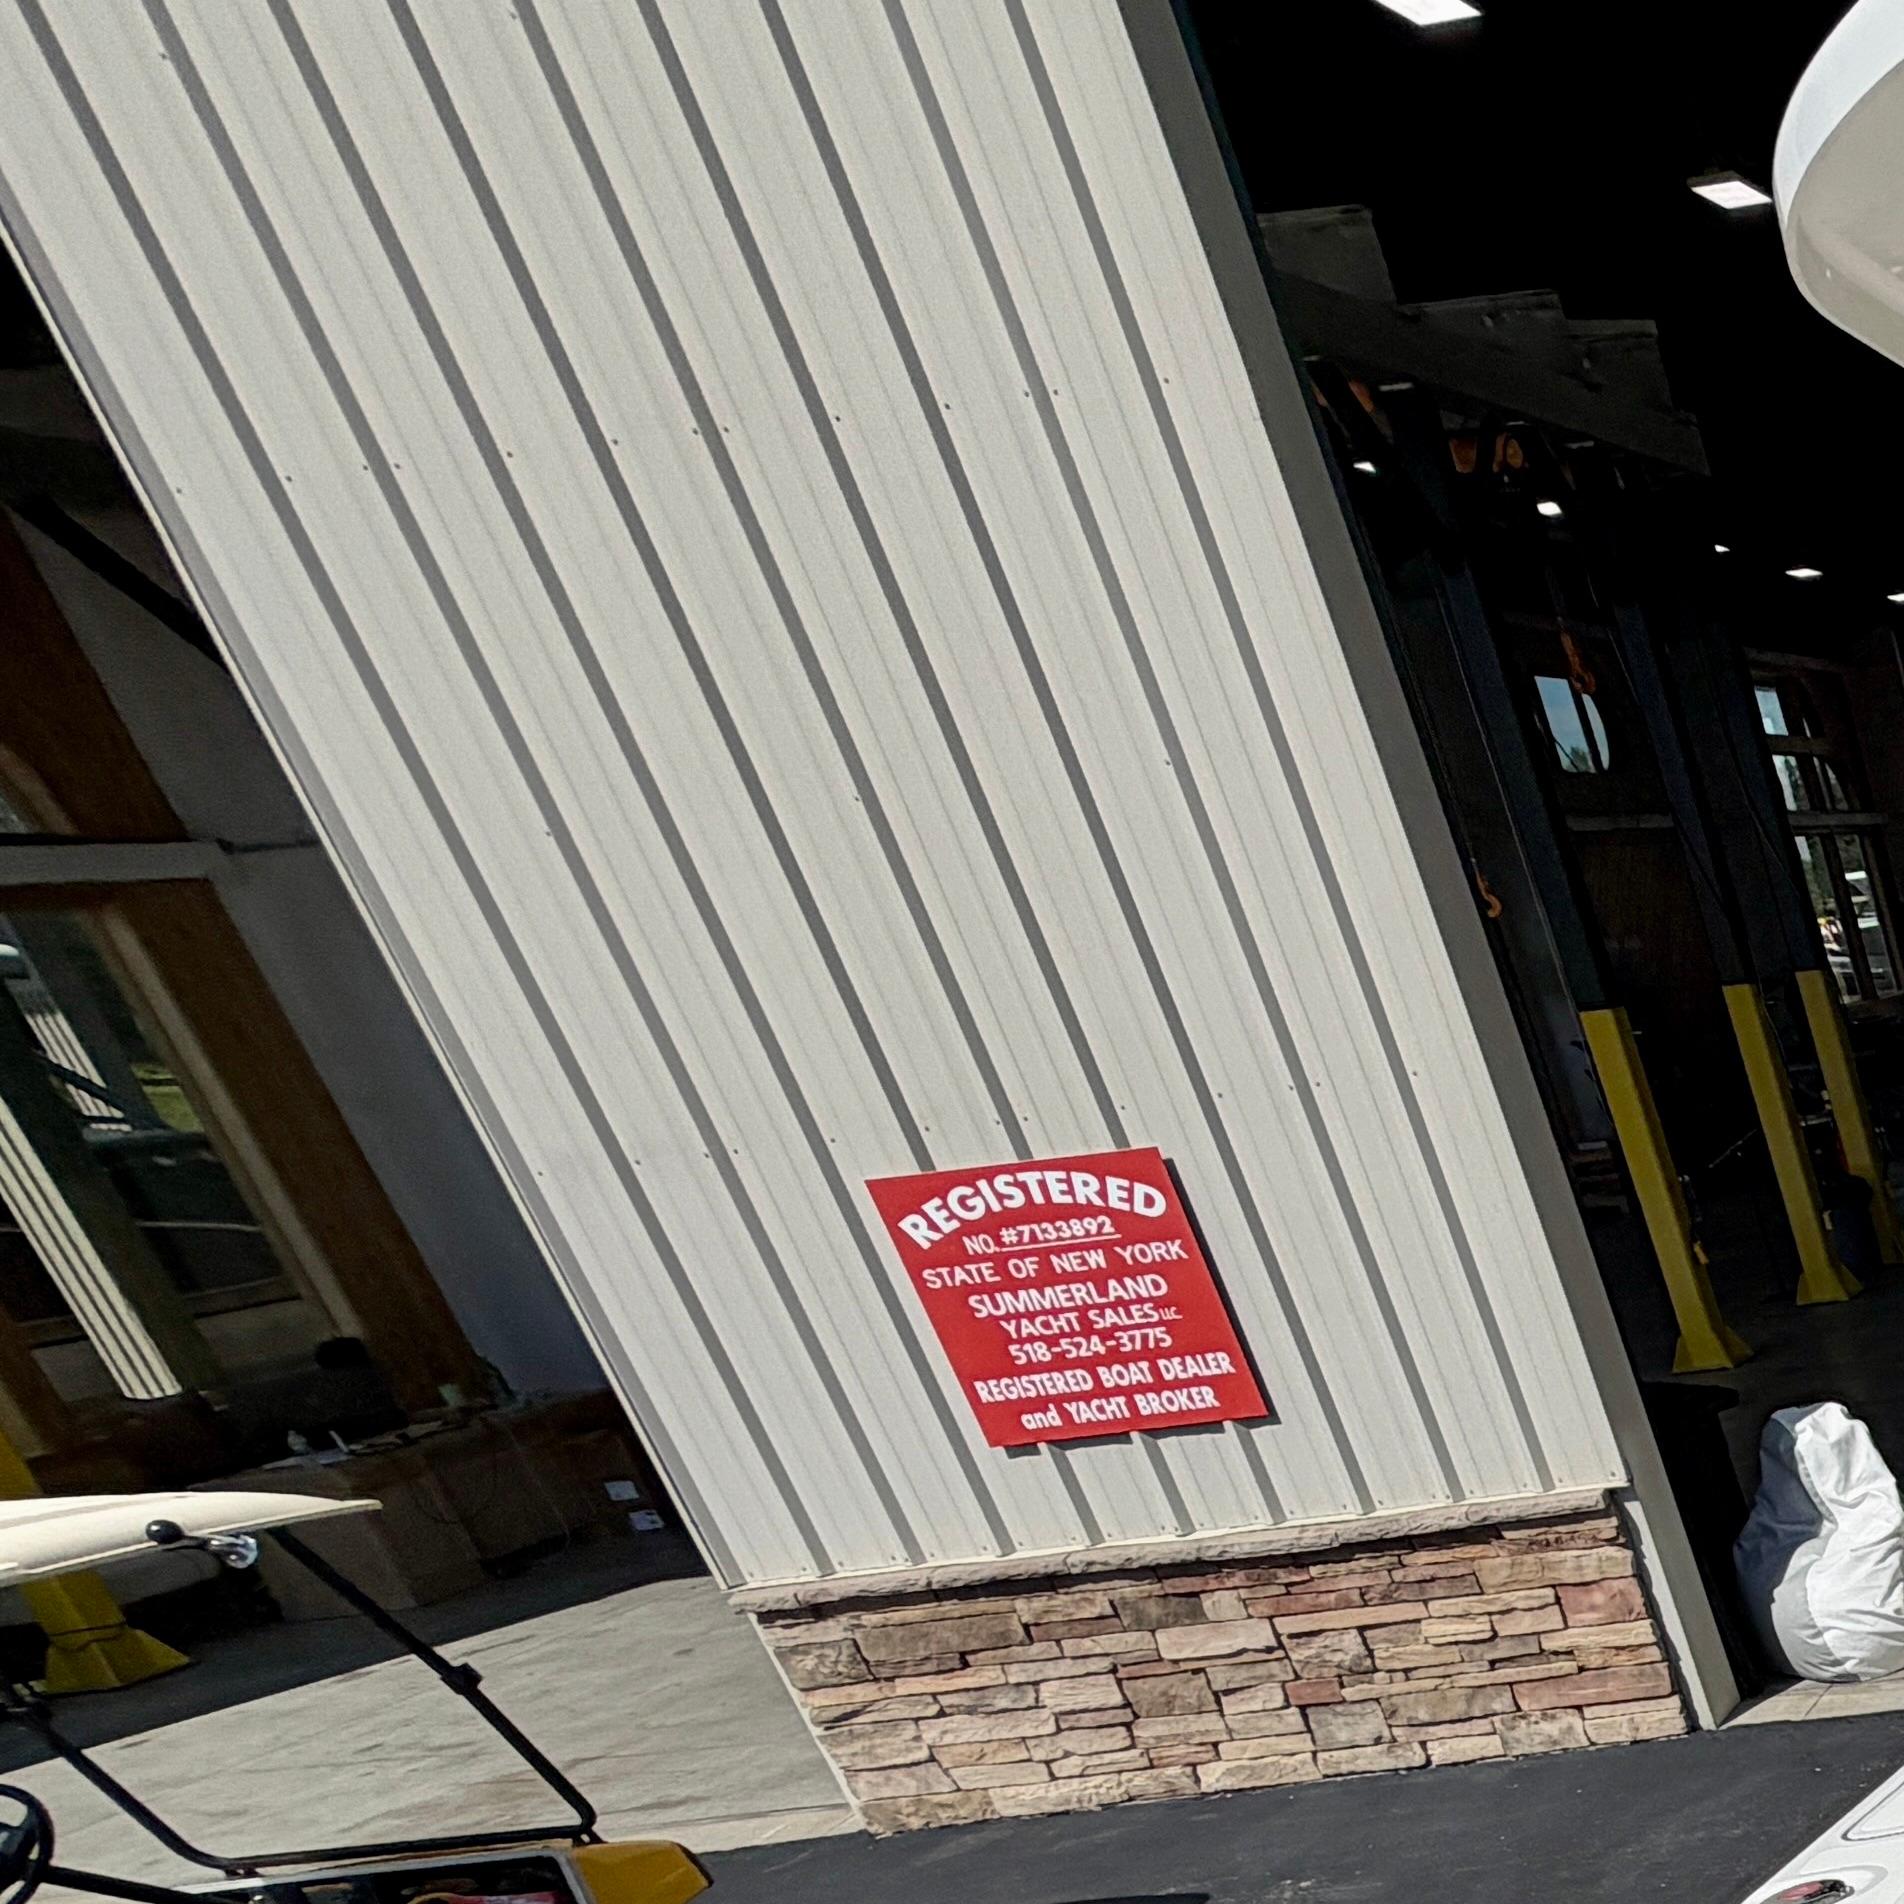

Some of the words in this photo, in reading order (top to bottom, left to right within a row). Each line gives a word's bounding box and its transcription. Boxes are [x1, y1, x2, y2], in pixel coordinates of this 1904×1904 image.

[898, 1170, 1167, 1250] REGISTERED
[962, 1233, 999, 1256] NO.
[1000, 1215, 1116, 1245] #7133892
[922, 1261, 1001, 1289] STATE
[1007, 1256, 1040, 1279] OF
[1050, 1248, 1108, 1274] NEW
[1113, 1239, 1189, 1266] YORK
[968, 1273, 1168, 1318] SUMMERLAND
[999, 1311, 1081, 1339] YACHT
[1087, 1302, 1160, 1329] SALES
[1008, 1326, 1173, 1365] 518-524-3775
[973, 1368, 1094, 1404] REGISTERED
[1096, 1360, 1154, 1389] BOAT
[1156, 1351, 1237, 1381] DEALER
[1020, 1403, 1063, 1430] and
[1062, 1396, 1131, 1424] YACHT
[1133, 1385, 1221, 1416] BROKER
